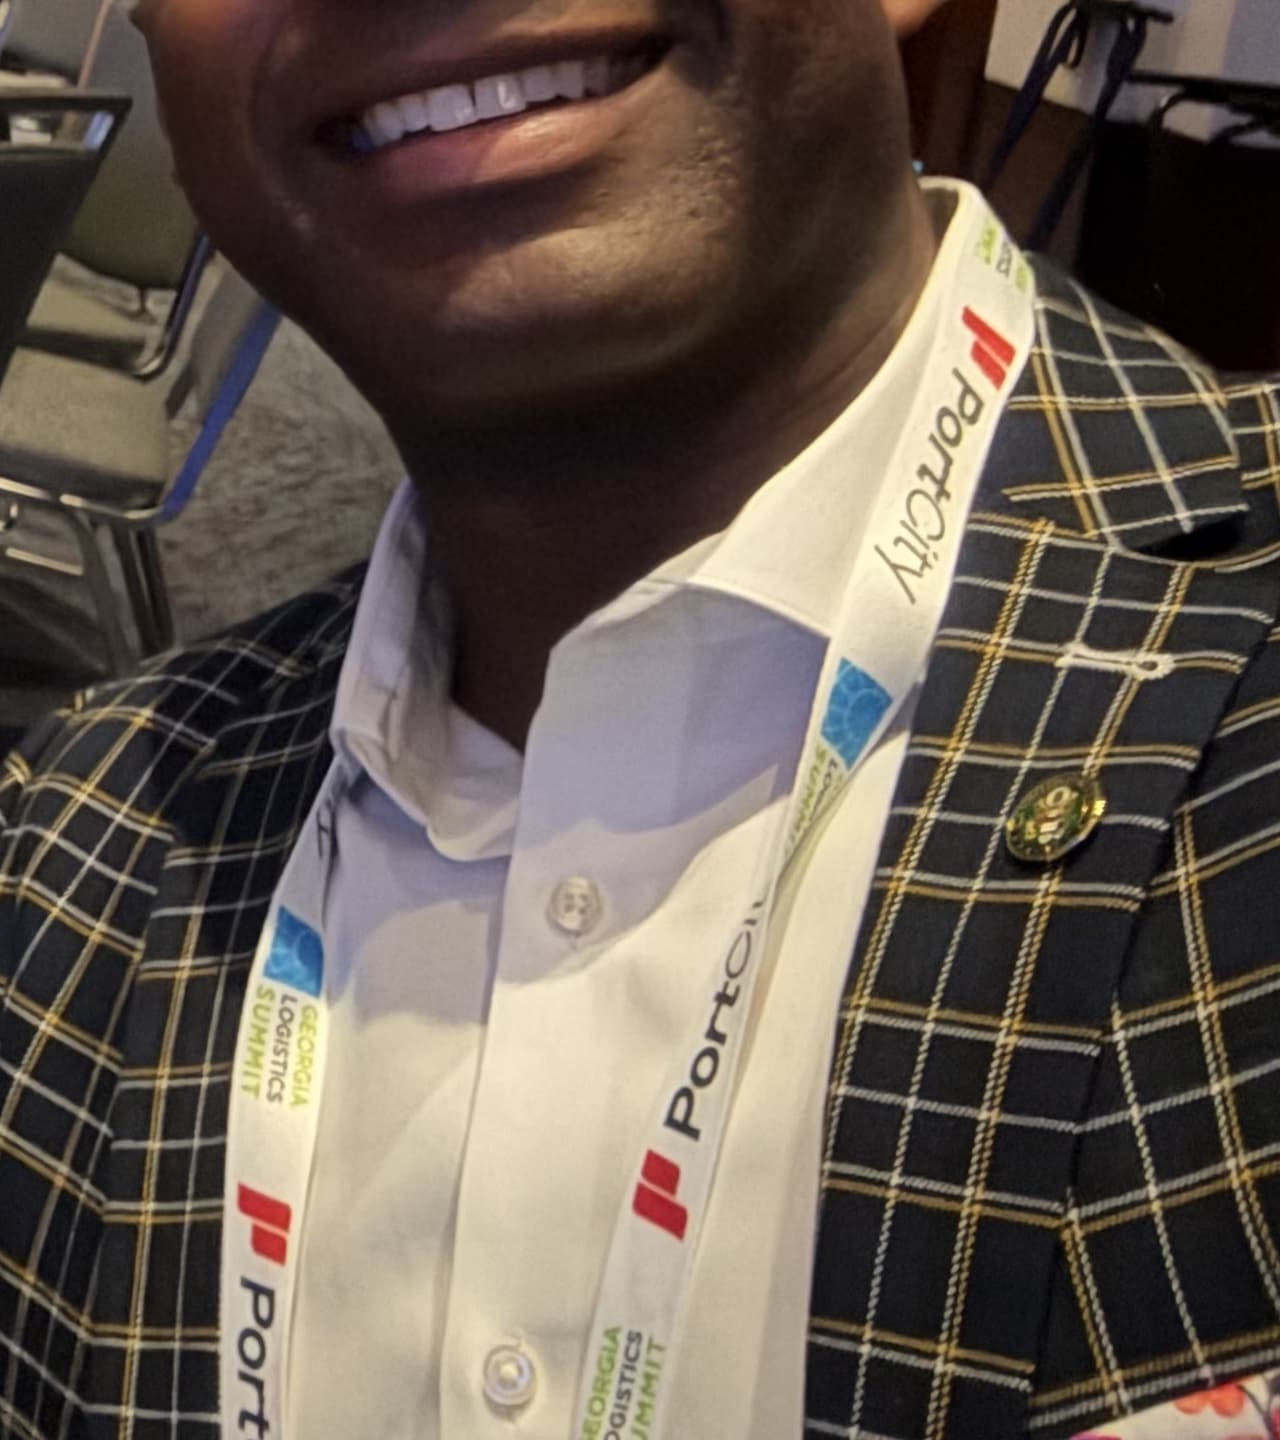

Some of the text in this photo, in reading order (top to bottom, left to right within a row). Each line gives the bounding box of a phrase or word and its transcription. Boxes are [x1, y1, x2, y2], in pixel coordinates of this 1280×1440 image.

[874, 367, 984, 605] PortCity
[241, 984, 276, 1100] SUMMIT
[266, 993, 298, 1104] LOGISTICS
[289, 1004, 319, 1109] GEORGIA
[238, 1276, 274, 1440] Port
[582, 1326, 622, 1440] EORGIA
[604, 1329, 642, 1440] OGISTICS
[631, 1335, 667, 1440] UMMIT
